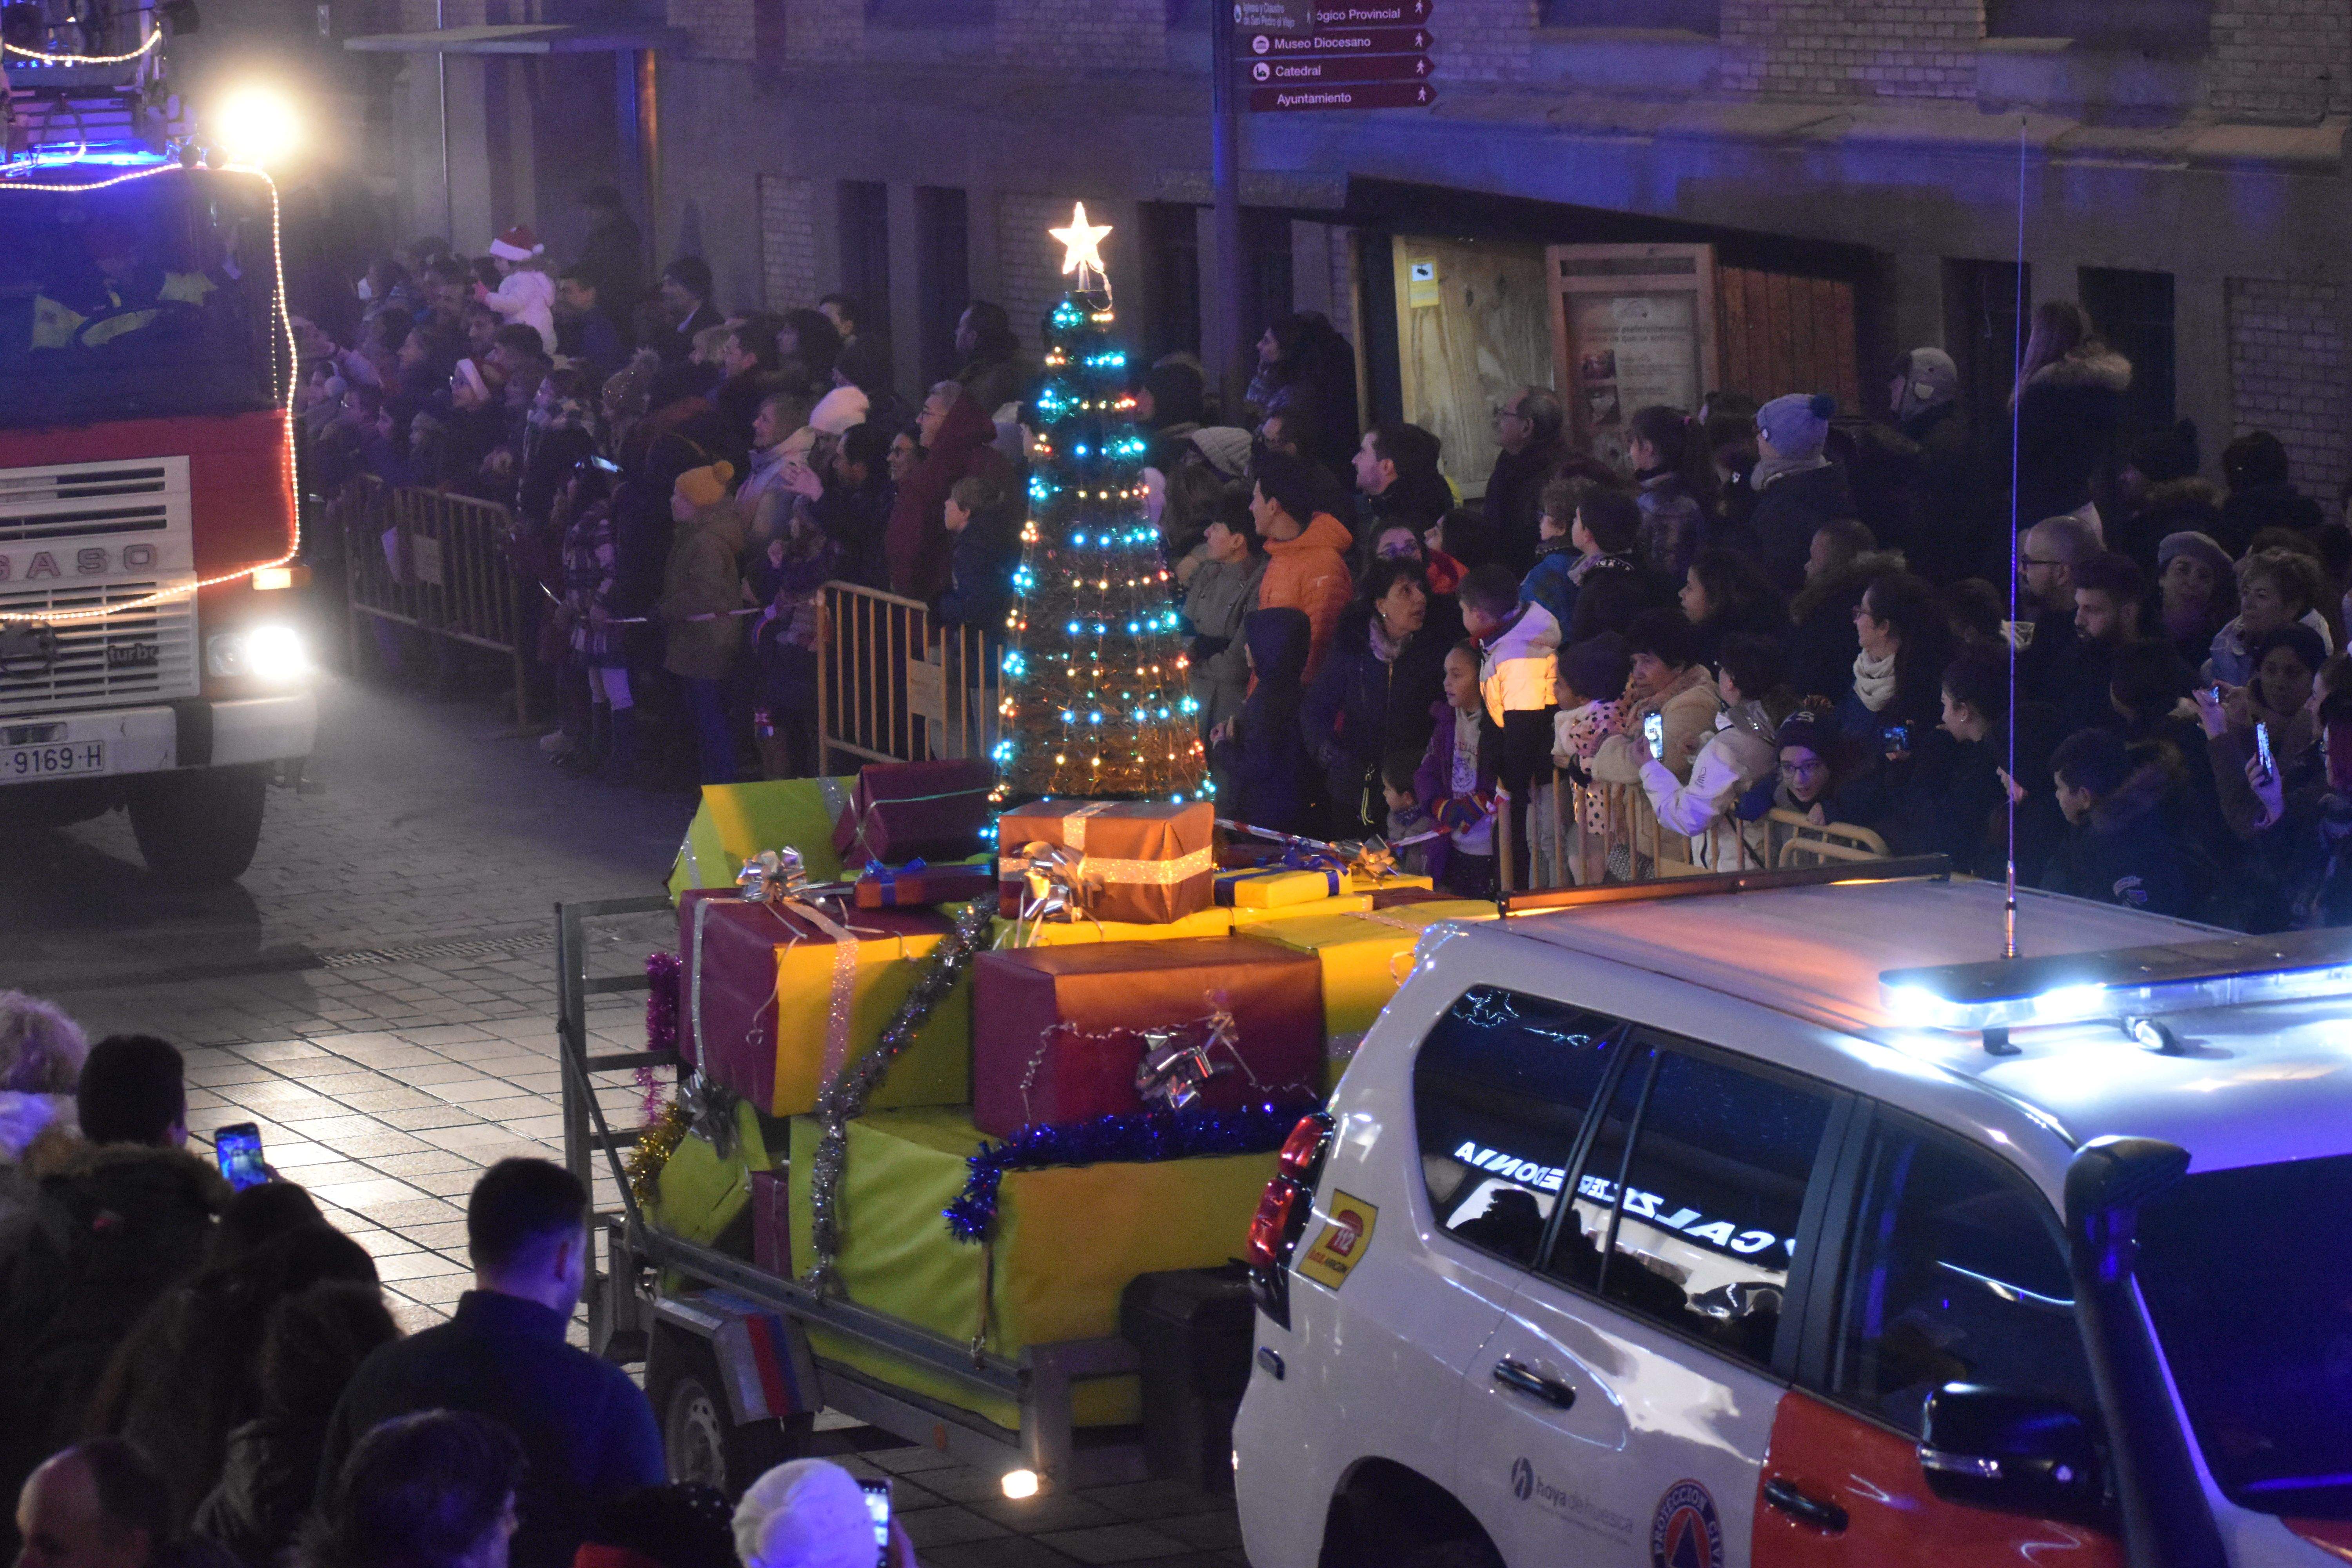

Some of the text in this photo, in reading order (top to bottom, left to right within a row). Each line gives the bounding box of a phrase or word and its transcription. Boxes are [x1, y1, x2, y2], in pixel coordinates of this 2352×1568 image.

[1349, 8, 1401, 20] Provincial
[1274, 37, 1371, 49] Museo Diocesano
[1275, 65, 1321, 77] Catedral
[1277, 92, 1352, 107] Ayuntamiento
